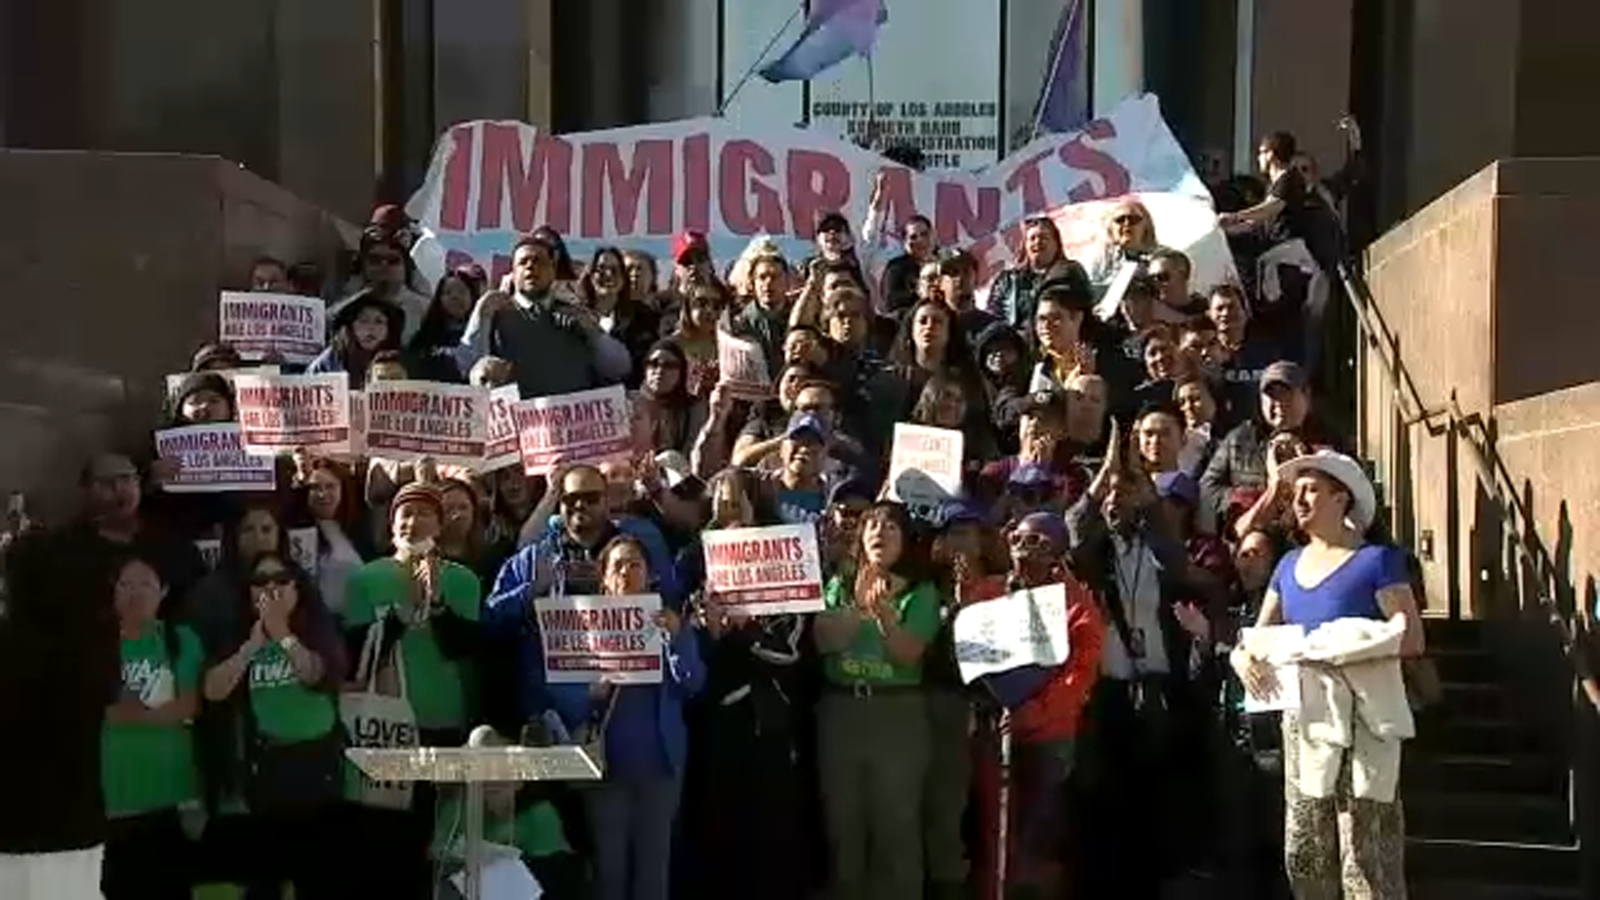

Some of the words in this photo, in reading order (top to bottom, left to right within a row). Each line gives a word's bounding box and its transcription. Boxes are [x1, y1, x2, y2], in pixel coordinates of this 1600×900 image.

[813, 102, 867, 117] COUNTY
[876, 102, 894, 117] OF
[901, 102, 927, 117] LOS
[935, 102, 996, 117] ANGELES
[440, 117, 1131, 246] IMMIGRANTS
[224, 302, 314, 324] IMMIGRANTS
[240, 385, 335, 408] IMMIGRANTS
[369, 392, 474, 418] IMMIGRANTS
[517, 398, 614, 429] IMMIGRANTS
[707, 536, 803, 566] IMMIGRANTS
[542, 607, 644, 631] IMMIGRANTS
[355, 715, 409, 744] LOVE
